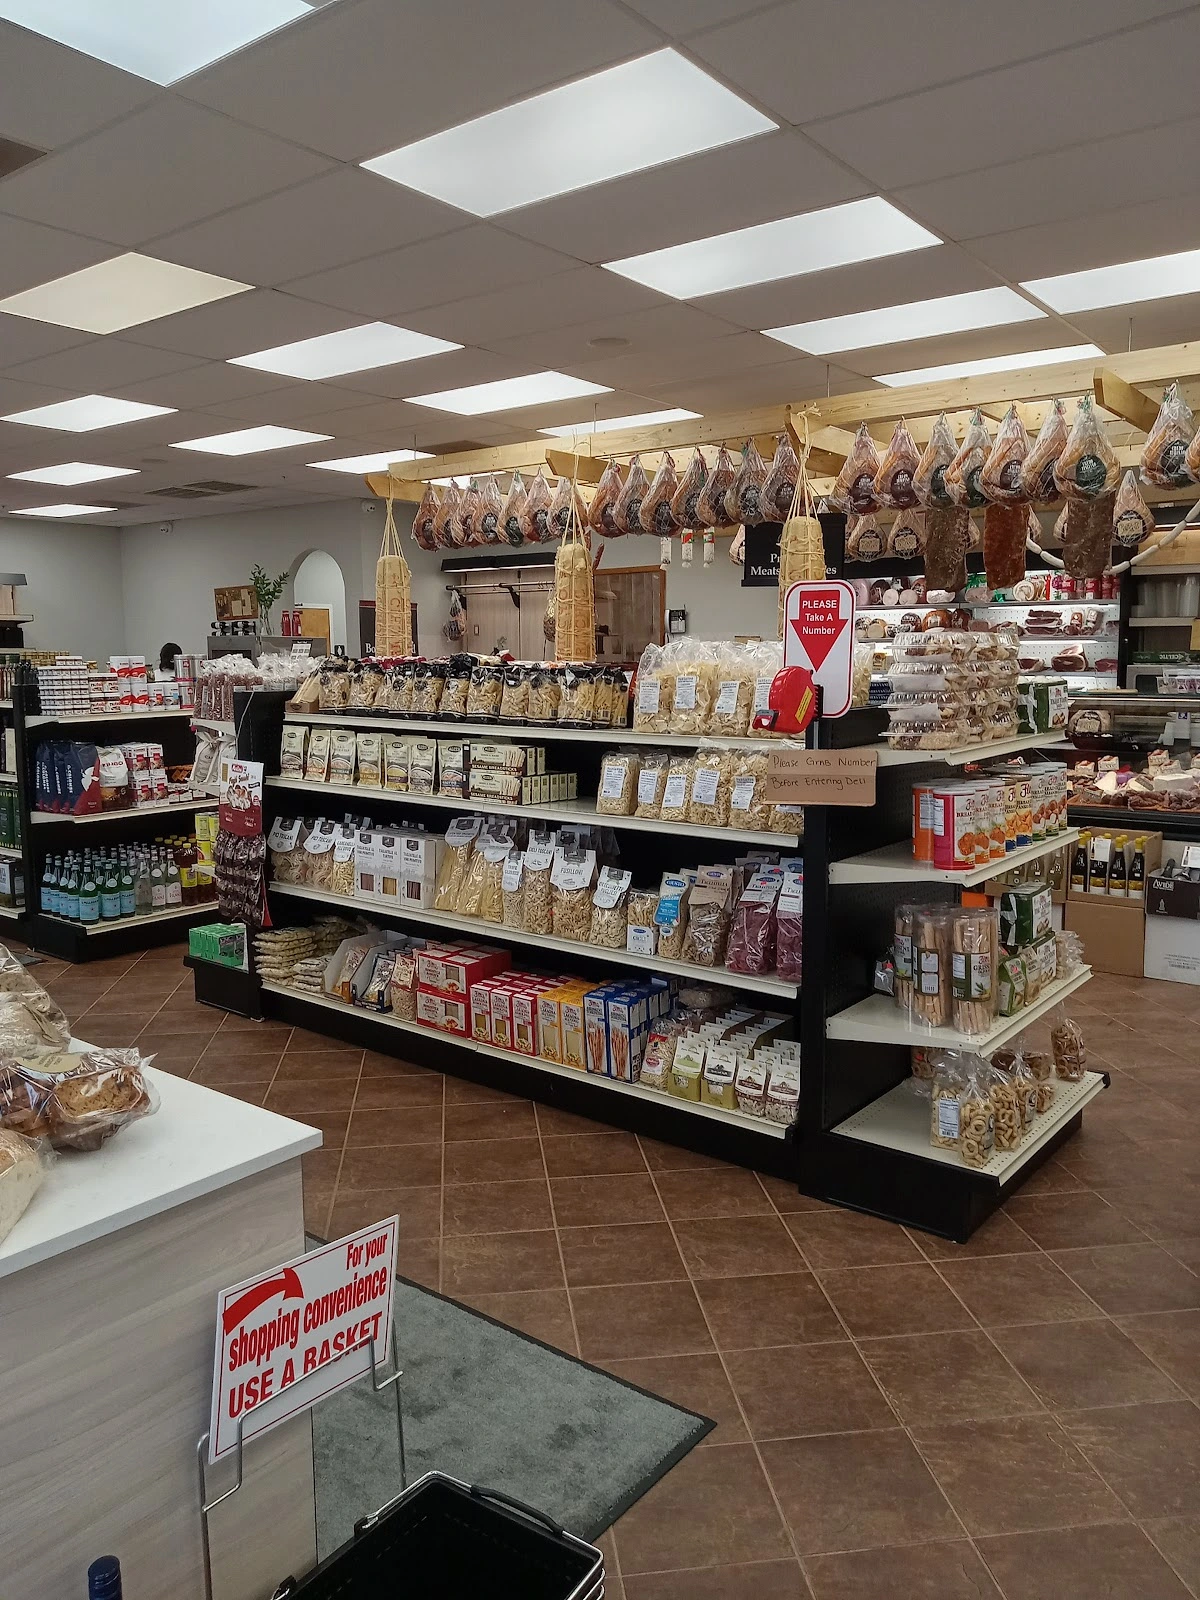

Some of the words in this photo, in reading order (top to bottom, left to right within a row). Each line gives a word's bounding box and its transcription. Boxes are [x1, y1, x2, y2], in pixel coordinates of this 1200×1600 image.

[802, 600, 837, 609] PLEASE
[805, 613, 824, 622] Take
[826, 613, 833, 621] A
[802, 626, 836, 635] Number
[772, 755, 799, 769] Please
[838, 757, 876, 767] Number
[770, 776, 799, 789] Before
[804, 776, 844, 791] Entering
[346, 1243, 362, 1271] For
[364, 1233, 388, 1267] your
[228, 1307, 300, 1372] shopping
[303, 1266, 387, 1334] convenience
[228, 1368, 274, 1419] USE
[280, 1357, 295, 1389] A
[303, 1311, 383, 1372] BASKET
